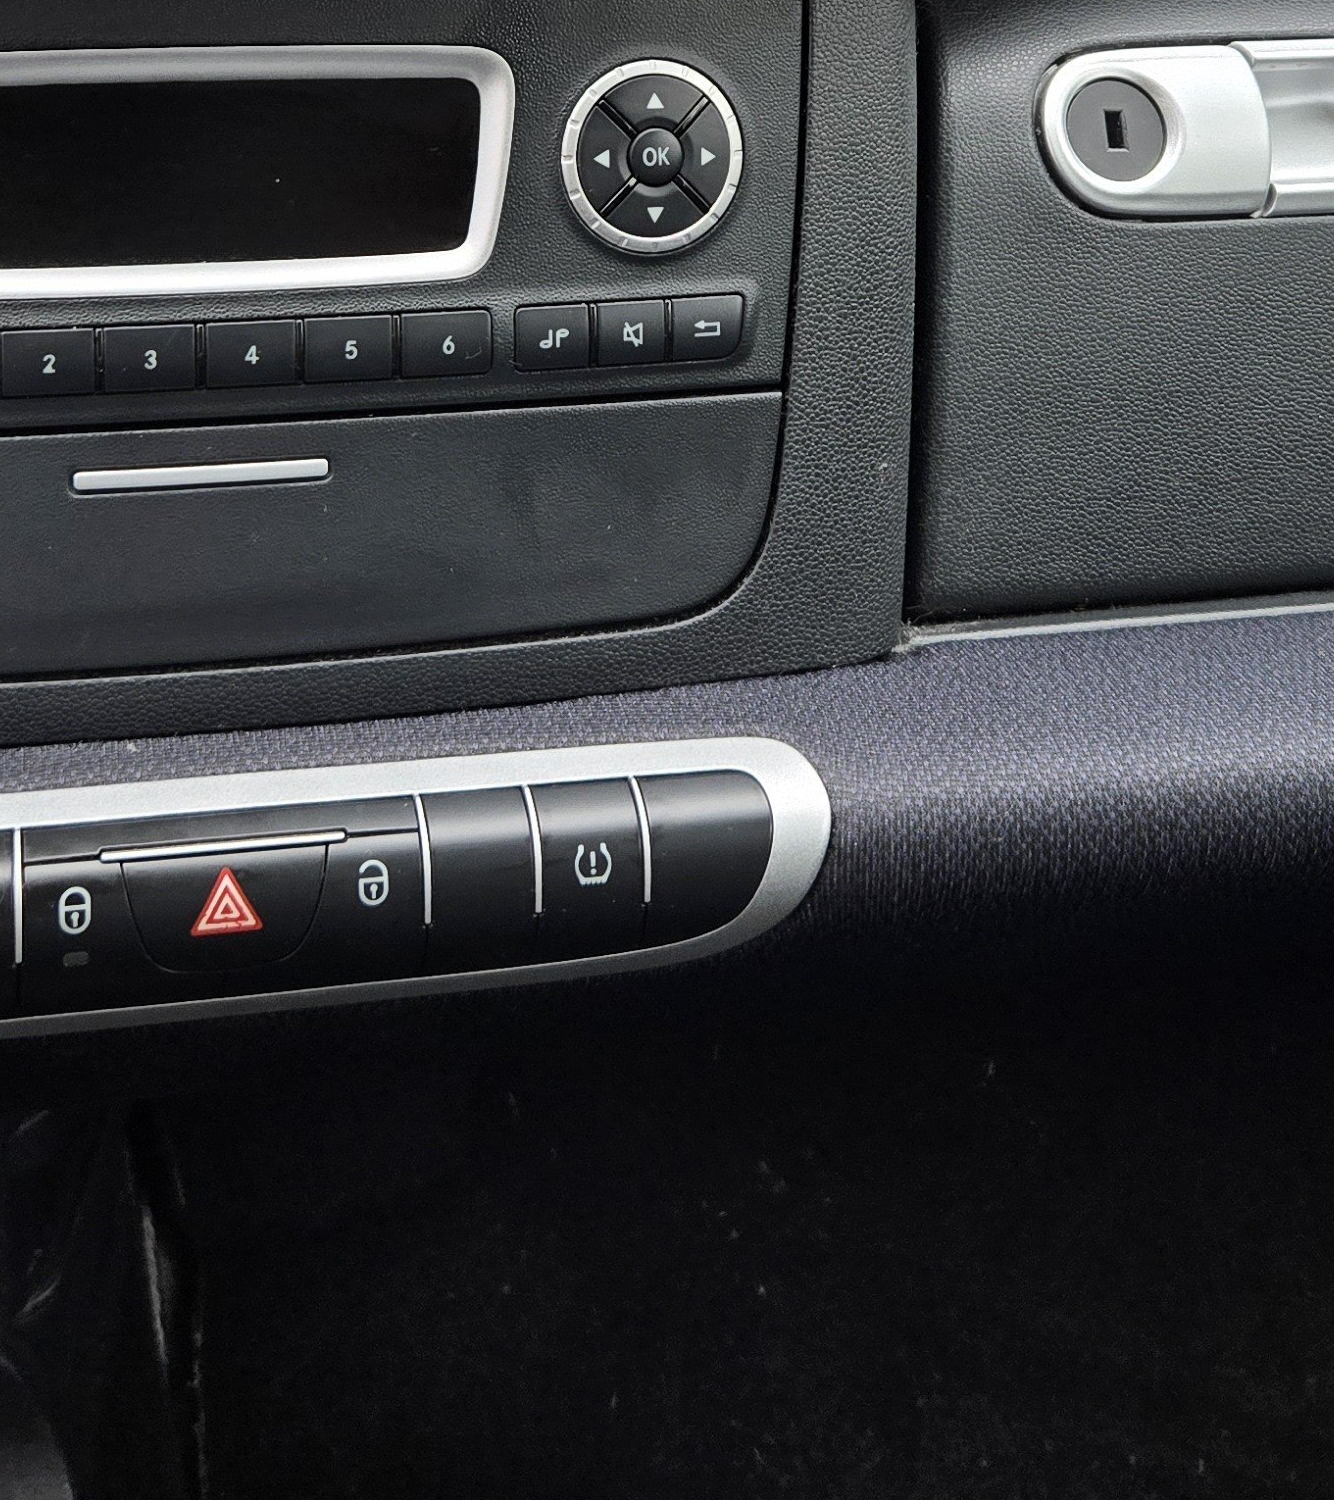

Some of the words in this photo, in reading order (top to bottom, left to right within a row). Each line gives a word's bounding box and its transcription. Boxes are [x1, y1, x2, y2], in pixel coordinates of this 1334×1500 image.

[642, 146, 670, 166] OK
[244, 345, 259, 364] 4
[345, 340, 358, 360] 5
[442, 335, 455, 354] 6
[42, 354, 56, 374] 2
[143, 349, 158, 370] 3
